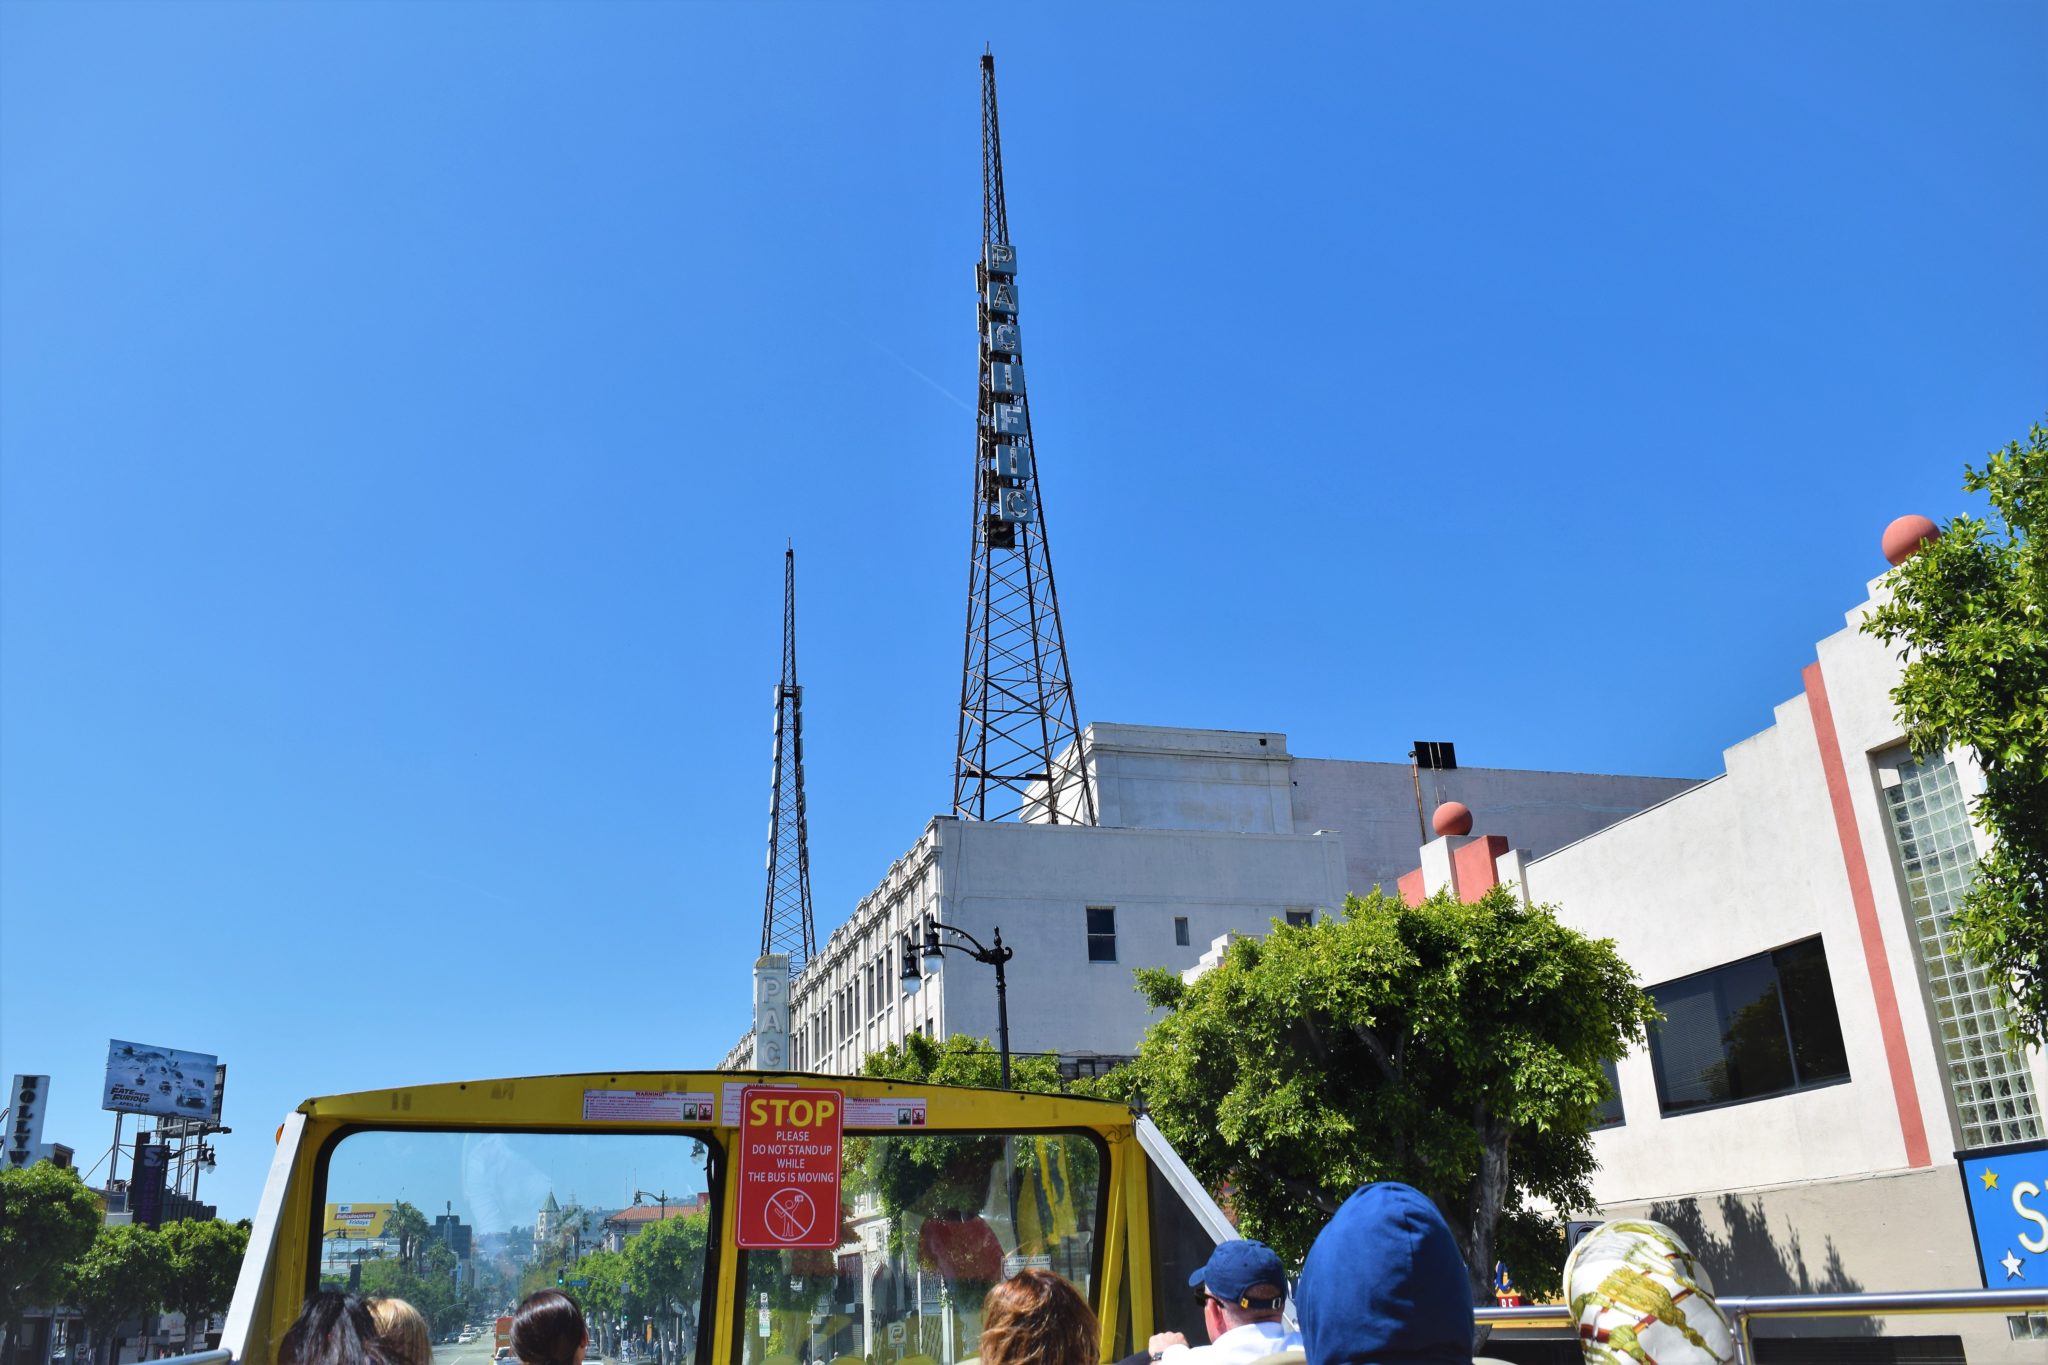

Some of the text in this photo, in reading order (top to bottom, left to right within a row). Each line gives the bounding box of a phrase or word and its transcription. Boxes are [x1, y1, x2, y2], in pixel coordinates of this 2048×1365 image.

[991, 244, 1028, 518] PACIFIC
[111, 1087, 135, 1095] FATE
[112, 1094, 150, 1103] FURIOUS
[750, 1098, 835, 1127] STOP
[9, 1075, 37, 1168] HOLLYW
[776, 1131, 810, 1142] PLEASE
[752, 1144, 832, 1155] DO NOT STAND UP
[776, 1158, 805, 1169] WHILE
[748, 1172, 834, 1183] THE BUS IS MOVING
[2012, 1180, 2048, 1254] S
